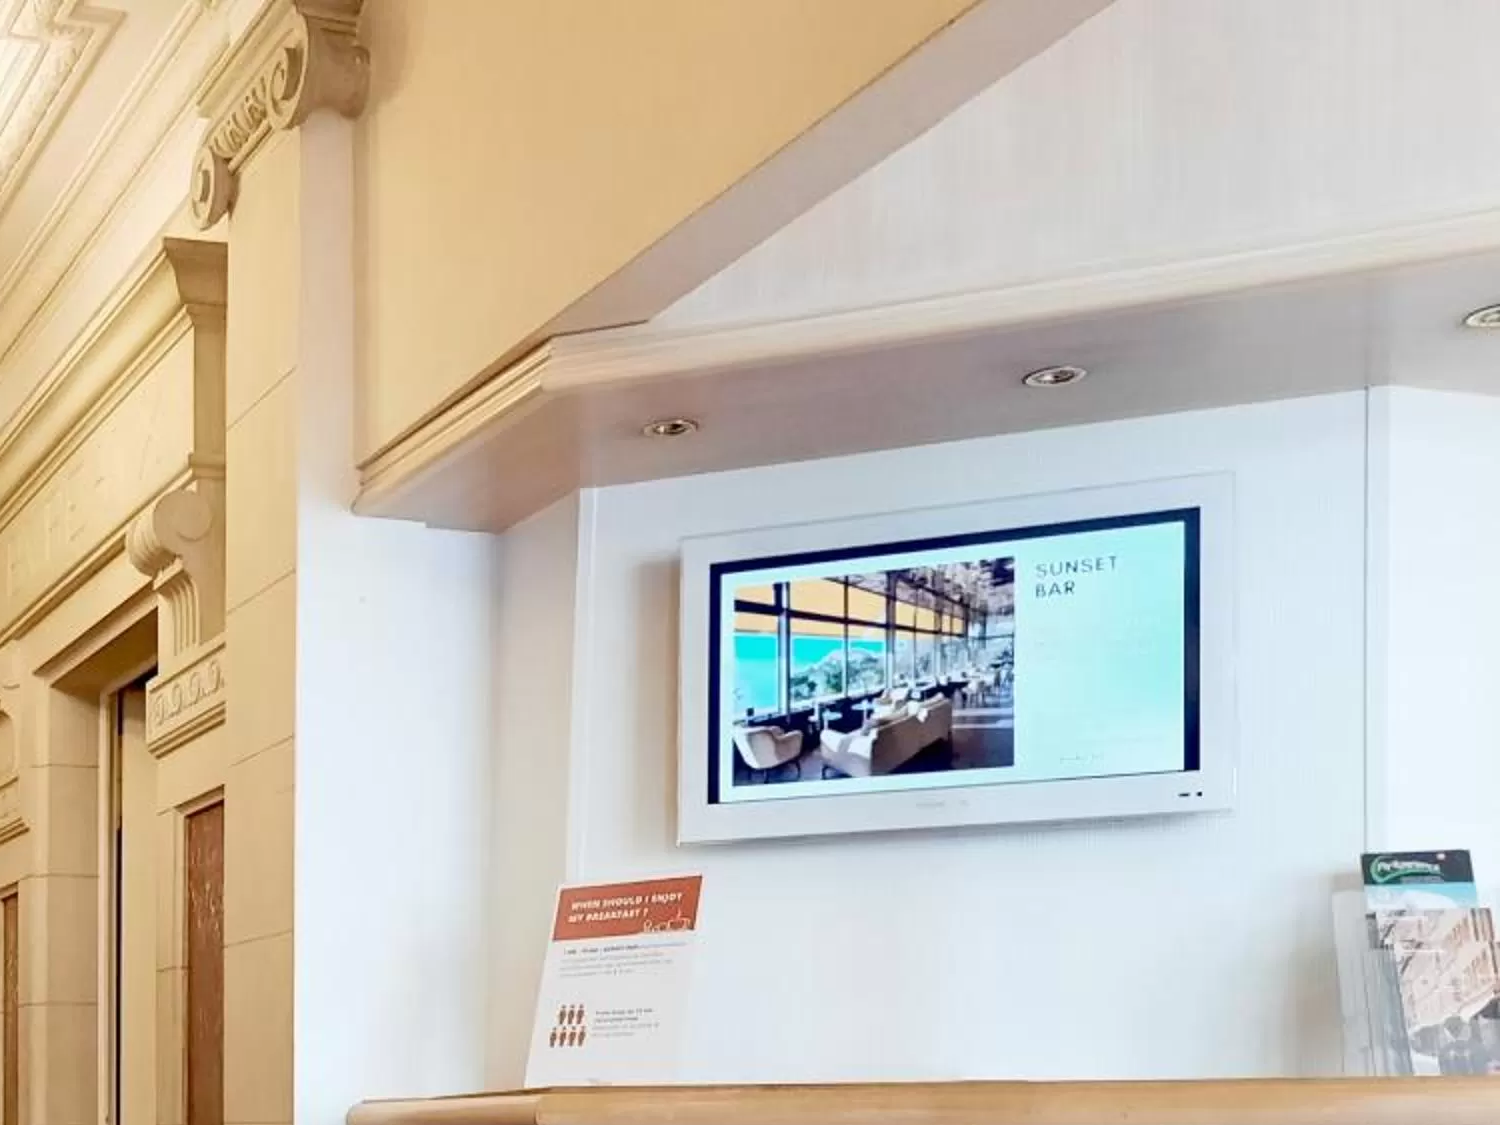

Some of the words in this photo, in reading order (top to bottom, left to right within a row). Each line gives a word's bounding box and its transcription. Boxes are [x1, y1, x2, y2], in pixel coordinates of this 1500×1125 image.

[1035, 556, 1116, 578] SUNSET
[1035, 580, 1075, 598] BAR
[571, 899, 600, 910] WHEN
[603, 895, 642, 908] SHOULD
[651, 892, 682, 903] ENJOY
[586, 908, 641, 921] BREAKFAST
